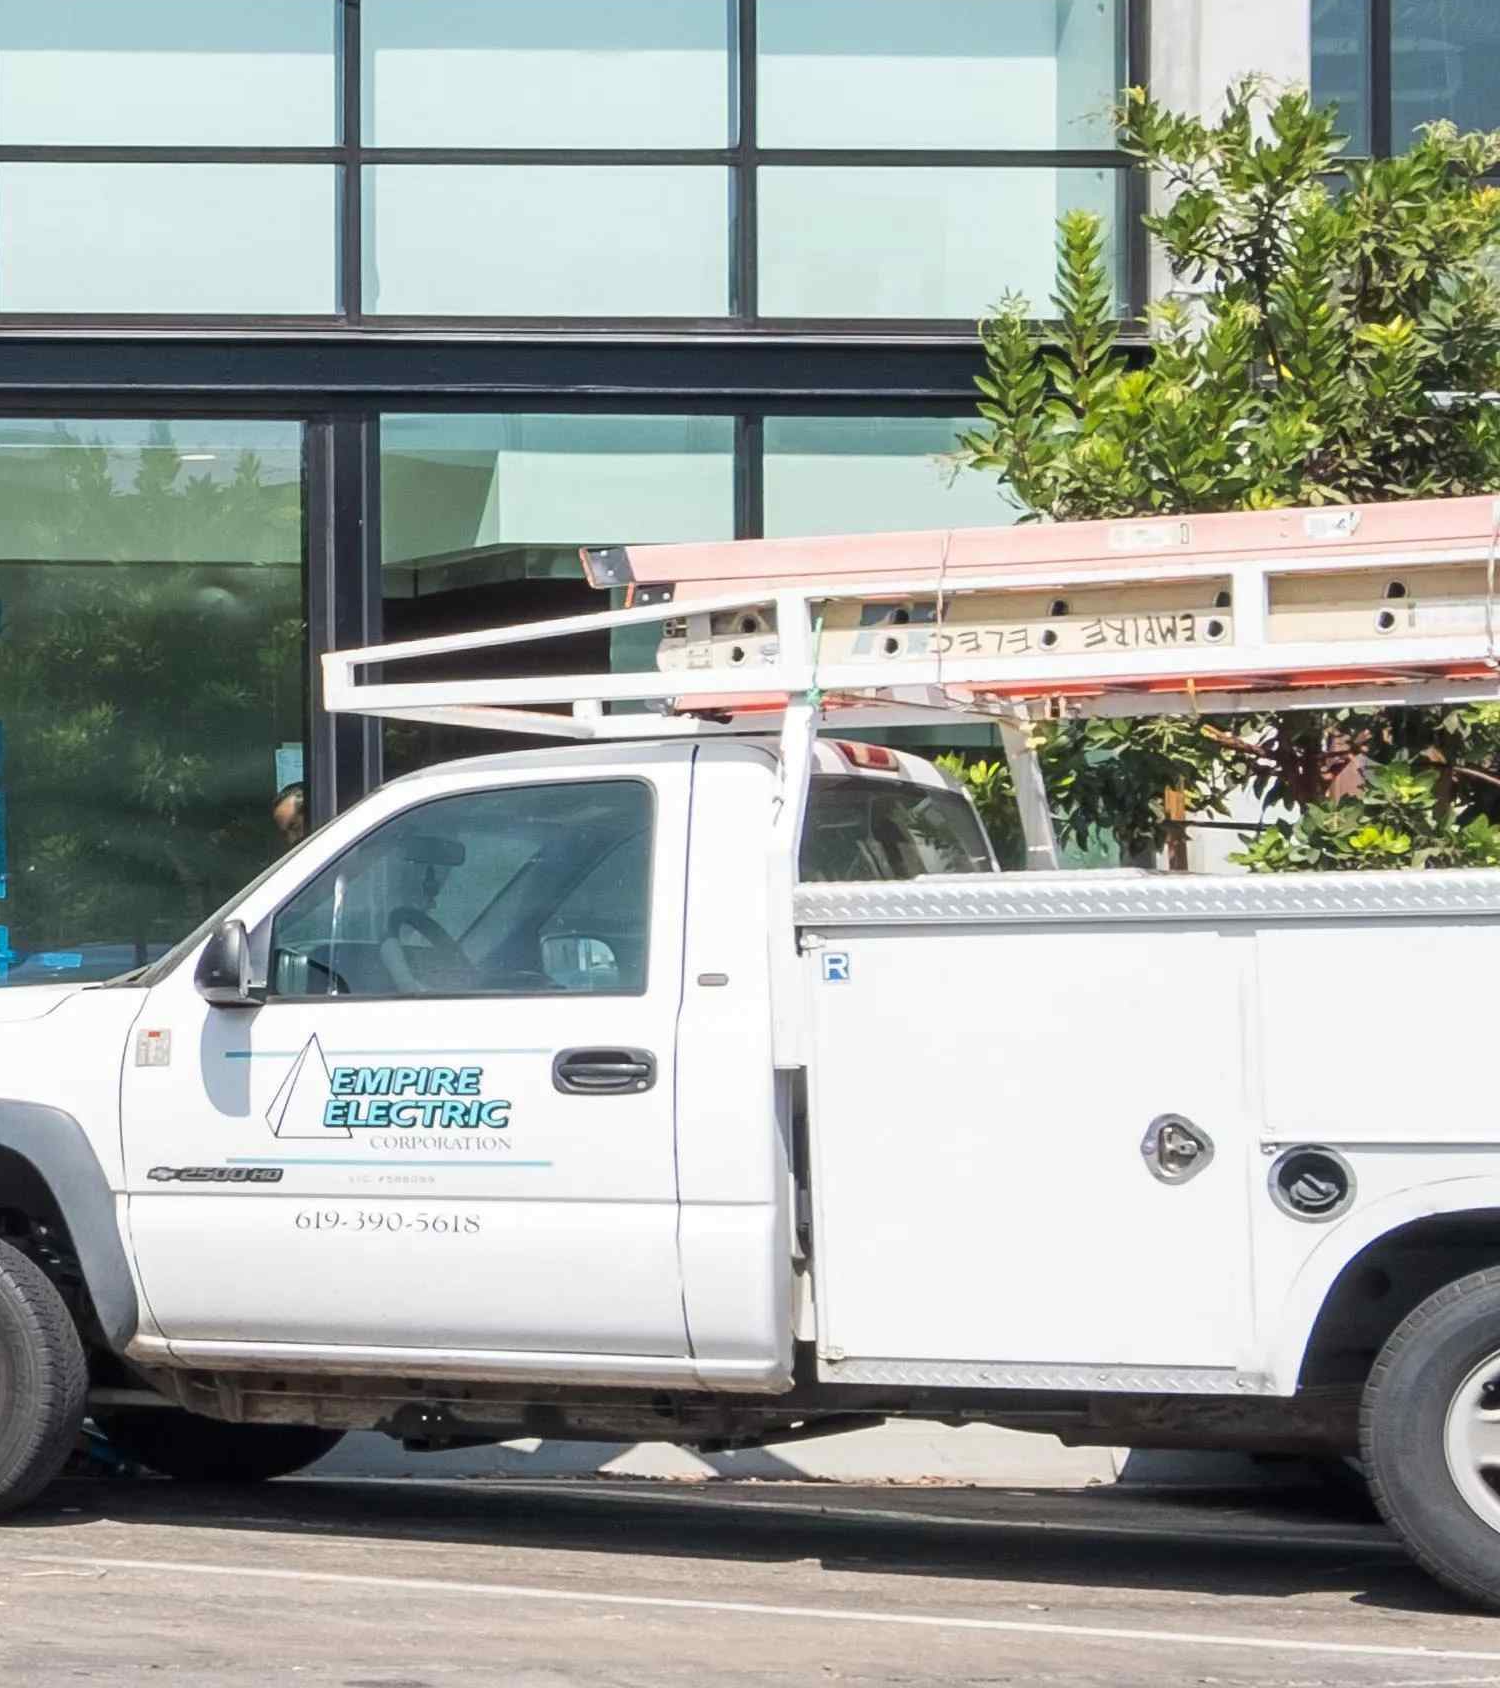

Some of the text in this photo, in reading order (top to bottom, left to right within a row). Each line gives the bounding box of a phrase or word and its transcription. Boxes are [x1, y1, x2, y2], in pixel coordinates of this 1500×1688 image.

[1081, 614, 1196, 648] EMPIRE
[824, 954, 849, 979] R
[331, 1066, 483, 1096] EMPIRE
[323, 1100, 511, 1128] ELECTRIC
[369, 1135, 512, 1151] CORPORATION
[180, 1167, 284, 1182] 2500 HD
[295, 1210, 481, 1234] 619-390-5618
